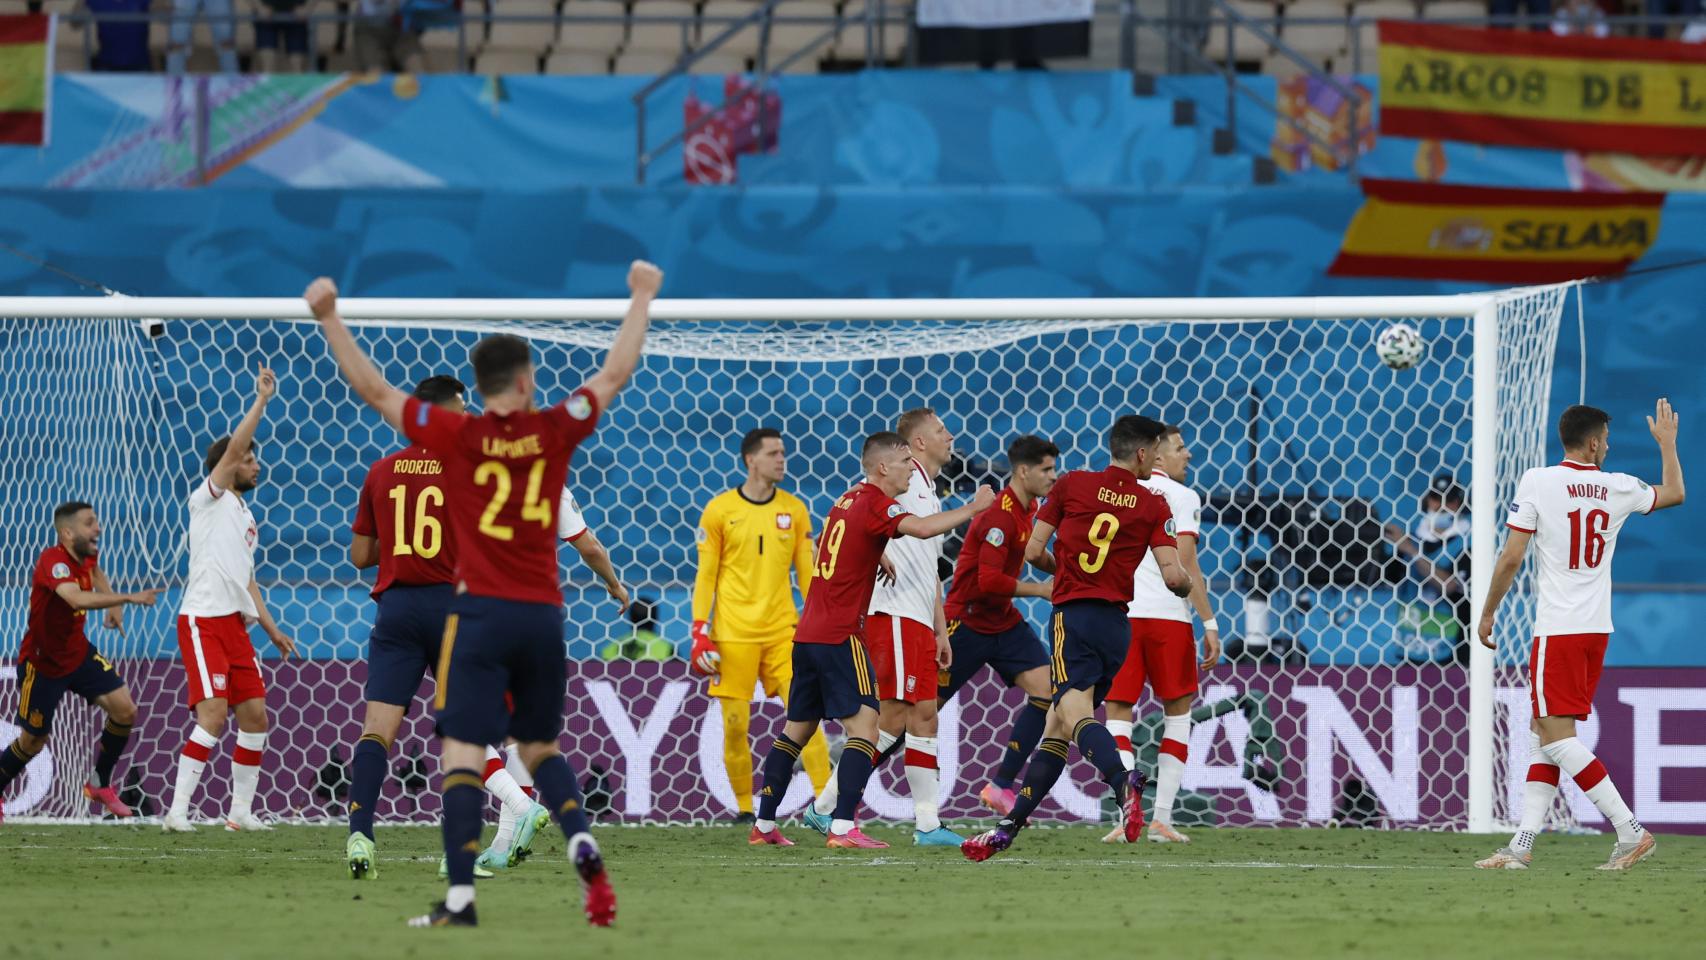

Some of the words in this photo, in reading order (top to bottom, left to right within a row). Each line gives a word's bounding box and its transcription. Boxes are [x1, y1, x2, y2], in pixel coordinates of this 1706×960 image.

[1396, 60, 1547, 106] ARCOS
[1581, 73, 1643, 111] DE
[1502, 218, 1649, 251] SELAYA
[473, 459, 552, 541] 24
[1097, 486, 1138, 509] GERARD
[1566, 483, 1609, 501] MODER
[389, 485, 444, 559] 16
[757, 534, 763, 555] 1
[812, 515, 846, 580] 19
[1078, 512, 1120, 574] 9
[1567, 507, 1610, 570] 16
